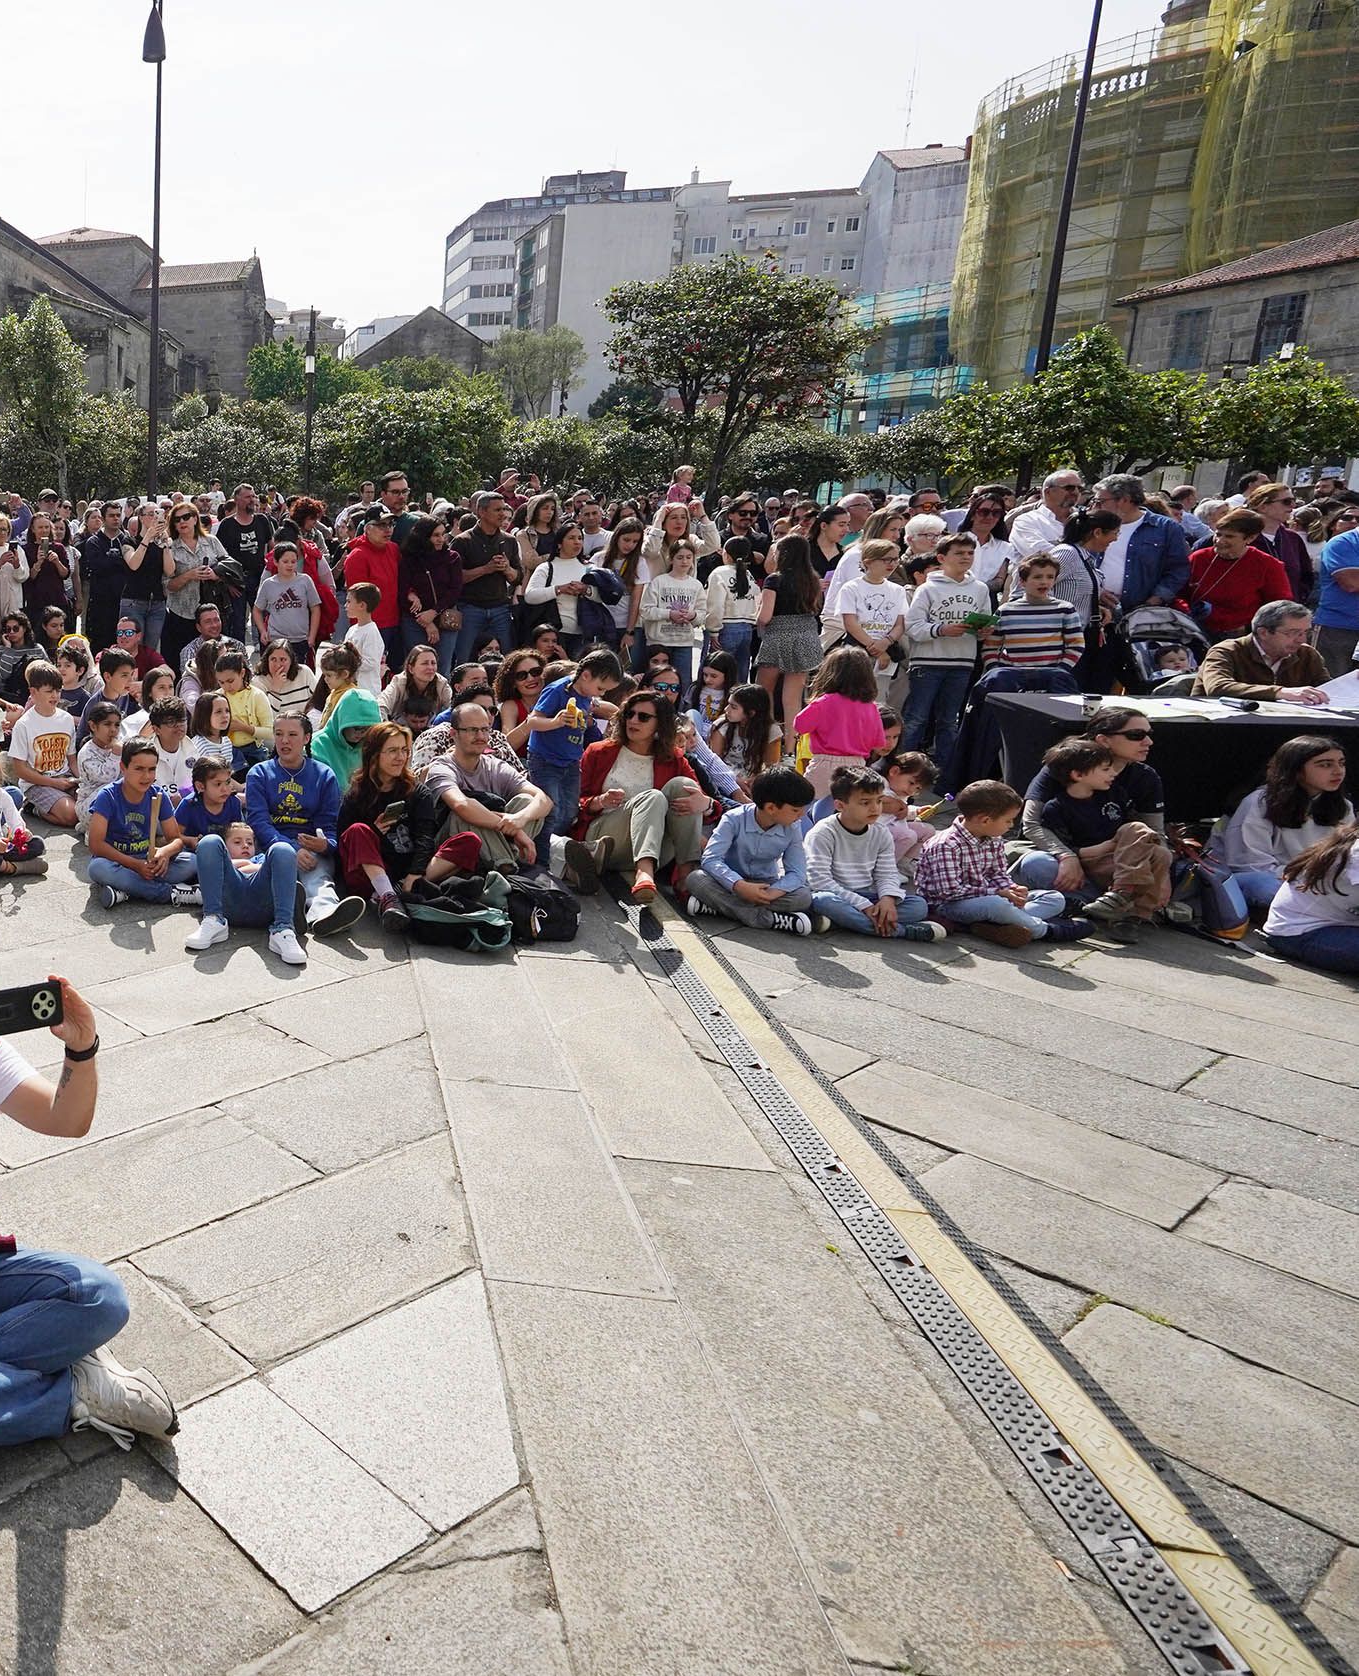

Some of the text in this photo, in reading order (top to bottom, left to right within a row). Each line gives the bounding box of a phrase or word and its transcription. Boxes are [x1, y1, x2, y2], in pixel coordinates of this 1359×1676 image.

[274, 600, 302, 610] adidas
[939, 610, 972, 621] COLLE
[37, 737, 67, 751] TOAST
[41, 748, 65, 762] RUSH
